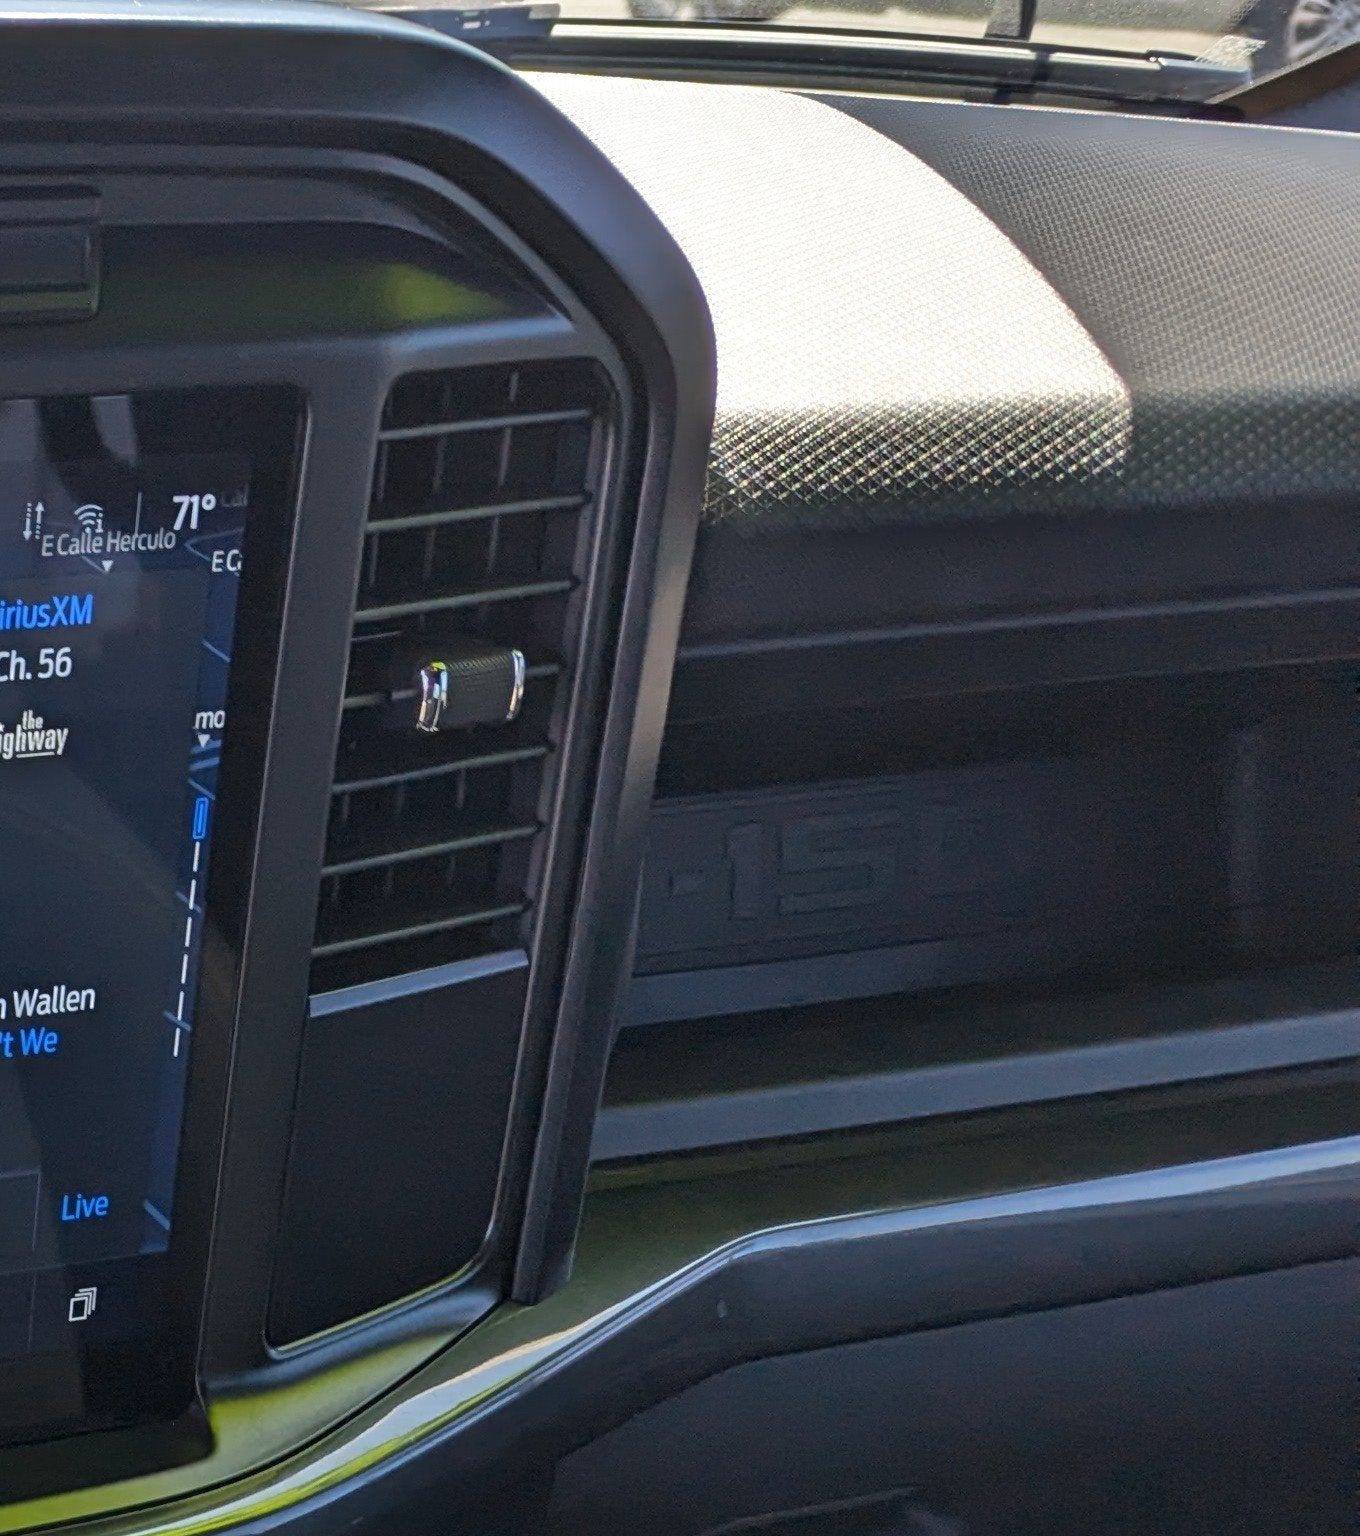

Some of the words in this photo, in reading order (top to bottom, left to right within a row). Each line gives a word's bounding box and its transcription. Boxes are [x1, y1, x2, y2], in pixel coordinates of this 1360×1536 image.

[41, 534, 54, 558] E
[56, 530, 103, 556] Calle
[106, 526, 176, 553] Herculo
[212, 550, 224, 573] E
[38, 646, 72, 680] 56
[22, 710, 43, 730] the
[12, 986, 97, 1021] Wallen
[20, 1027, 58, 1059] We
[61, 1191, 109, 1222] Live
